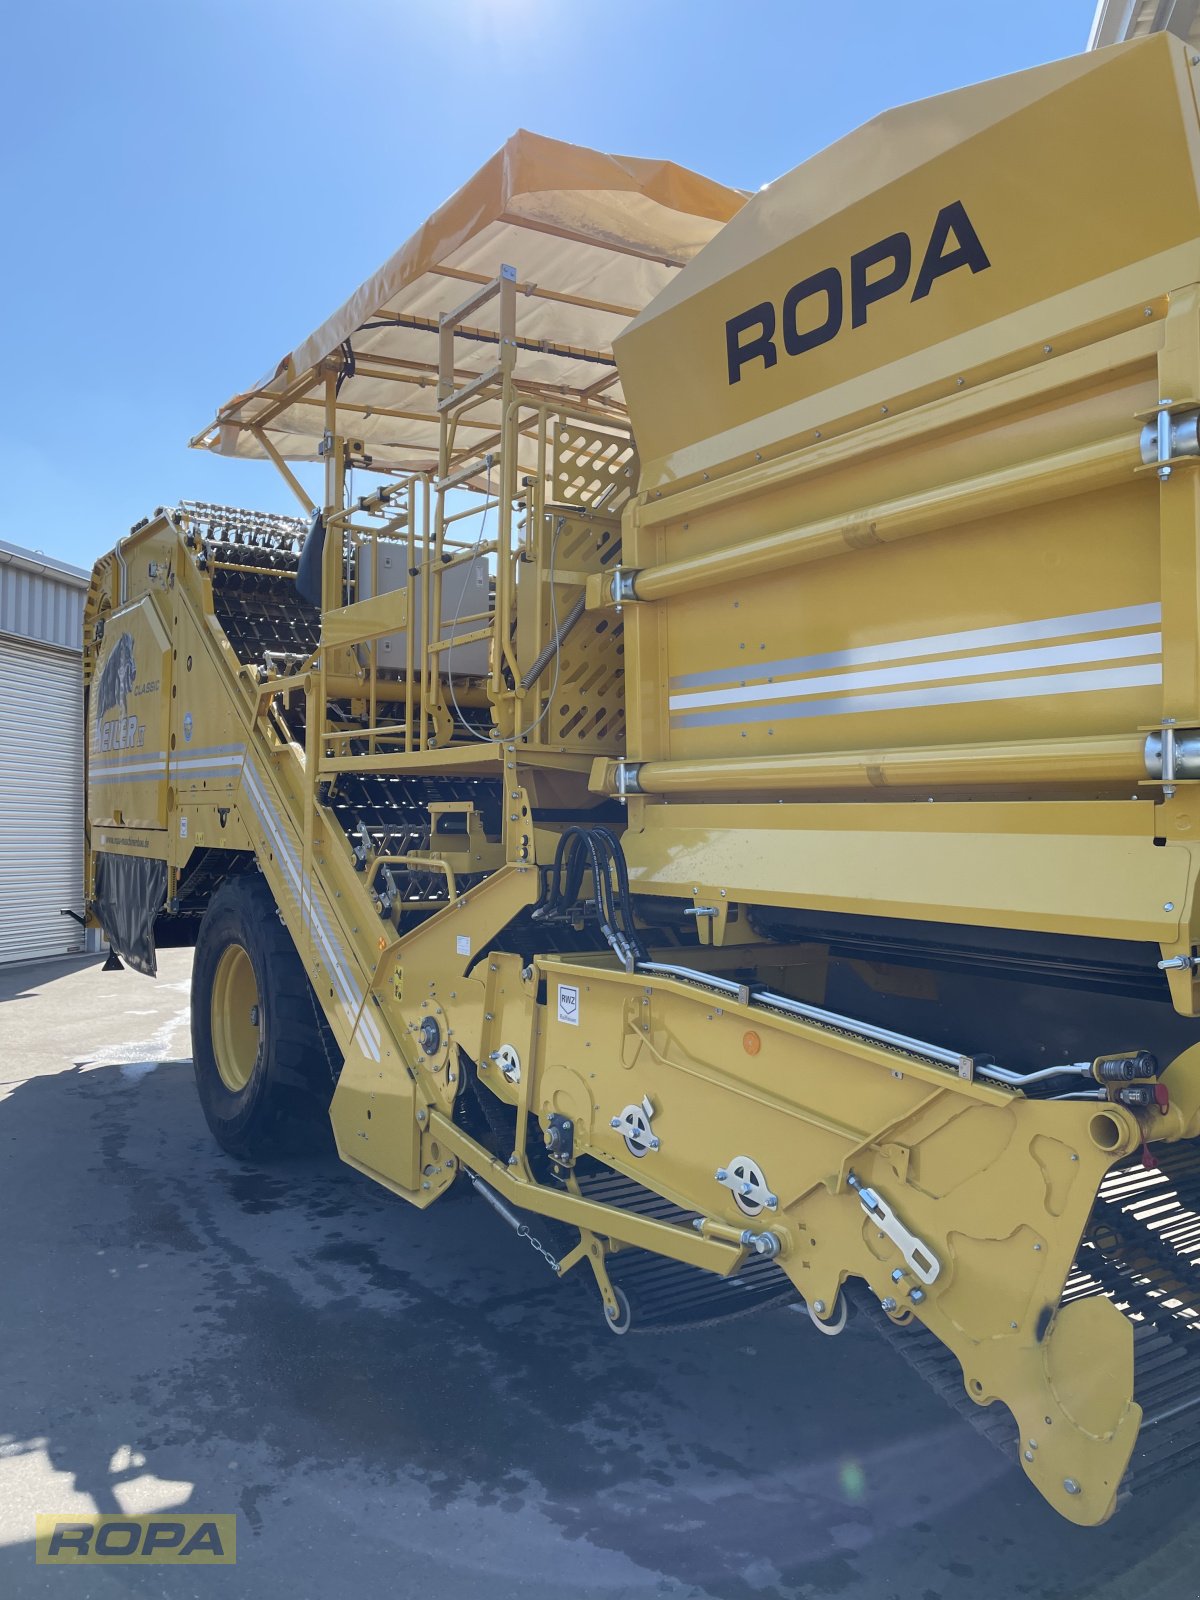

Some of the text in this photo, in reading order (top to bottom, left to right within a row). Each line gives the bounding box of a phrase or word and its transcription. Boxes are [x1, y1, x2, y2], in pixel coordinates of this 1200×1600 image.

[726, 200, 991, 385] ROPA
[134, 680, 160, 696] CLASSIC
[561, 994, 575, 1005] RWZ
